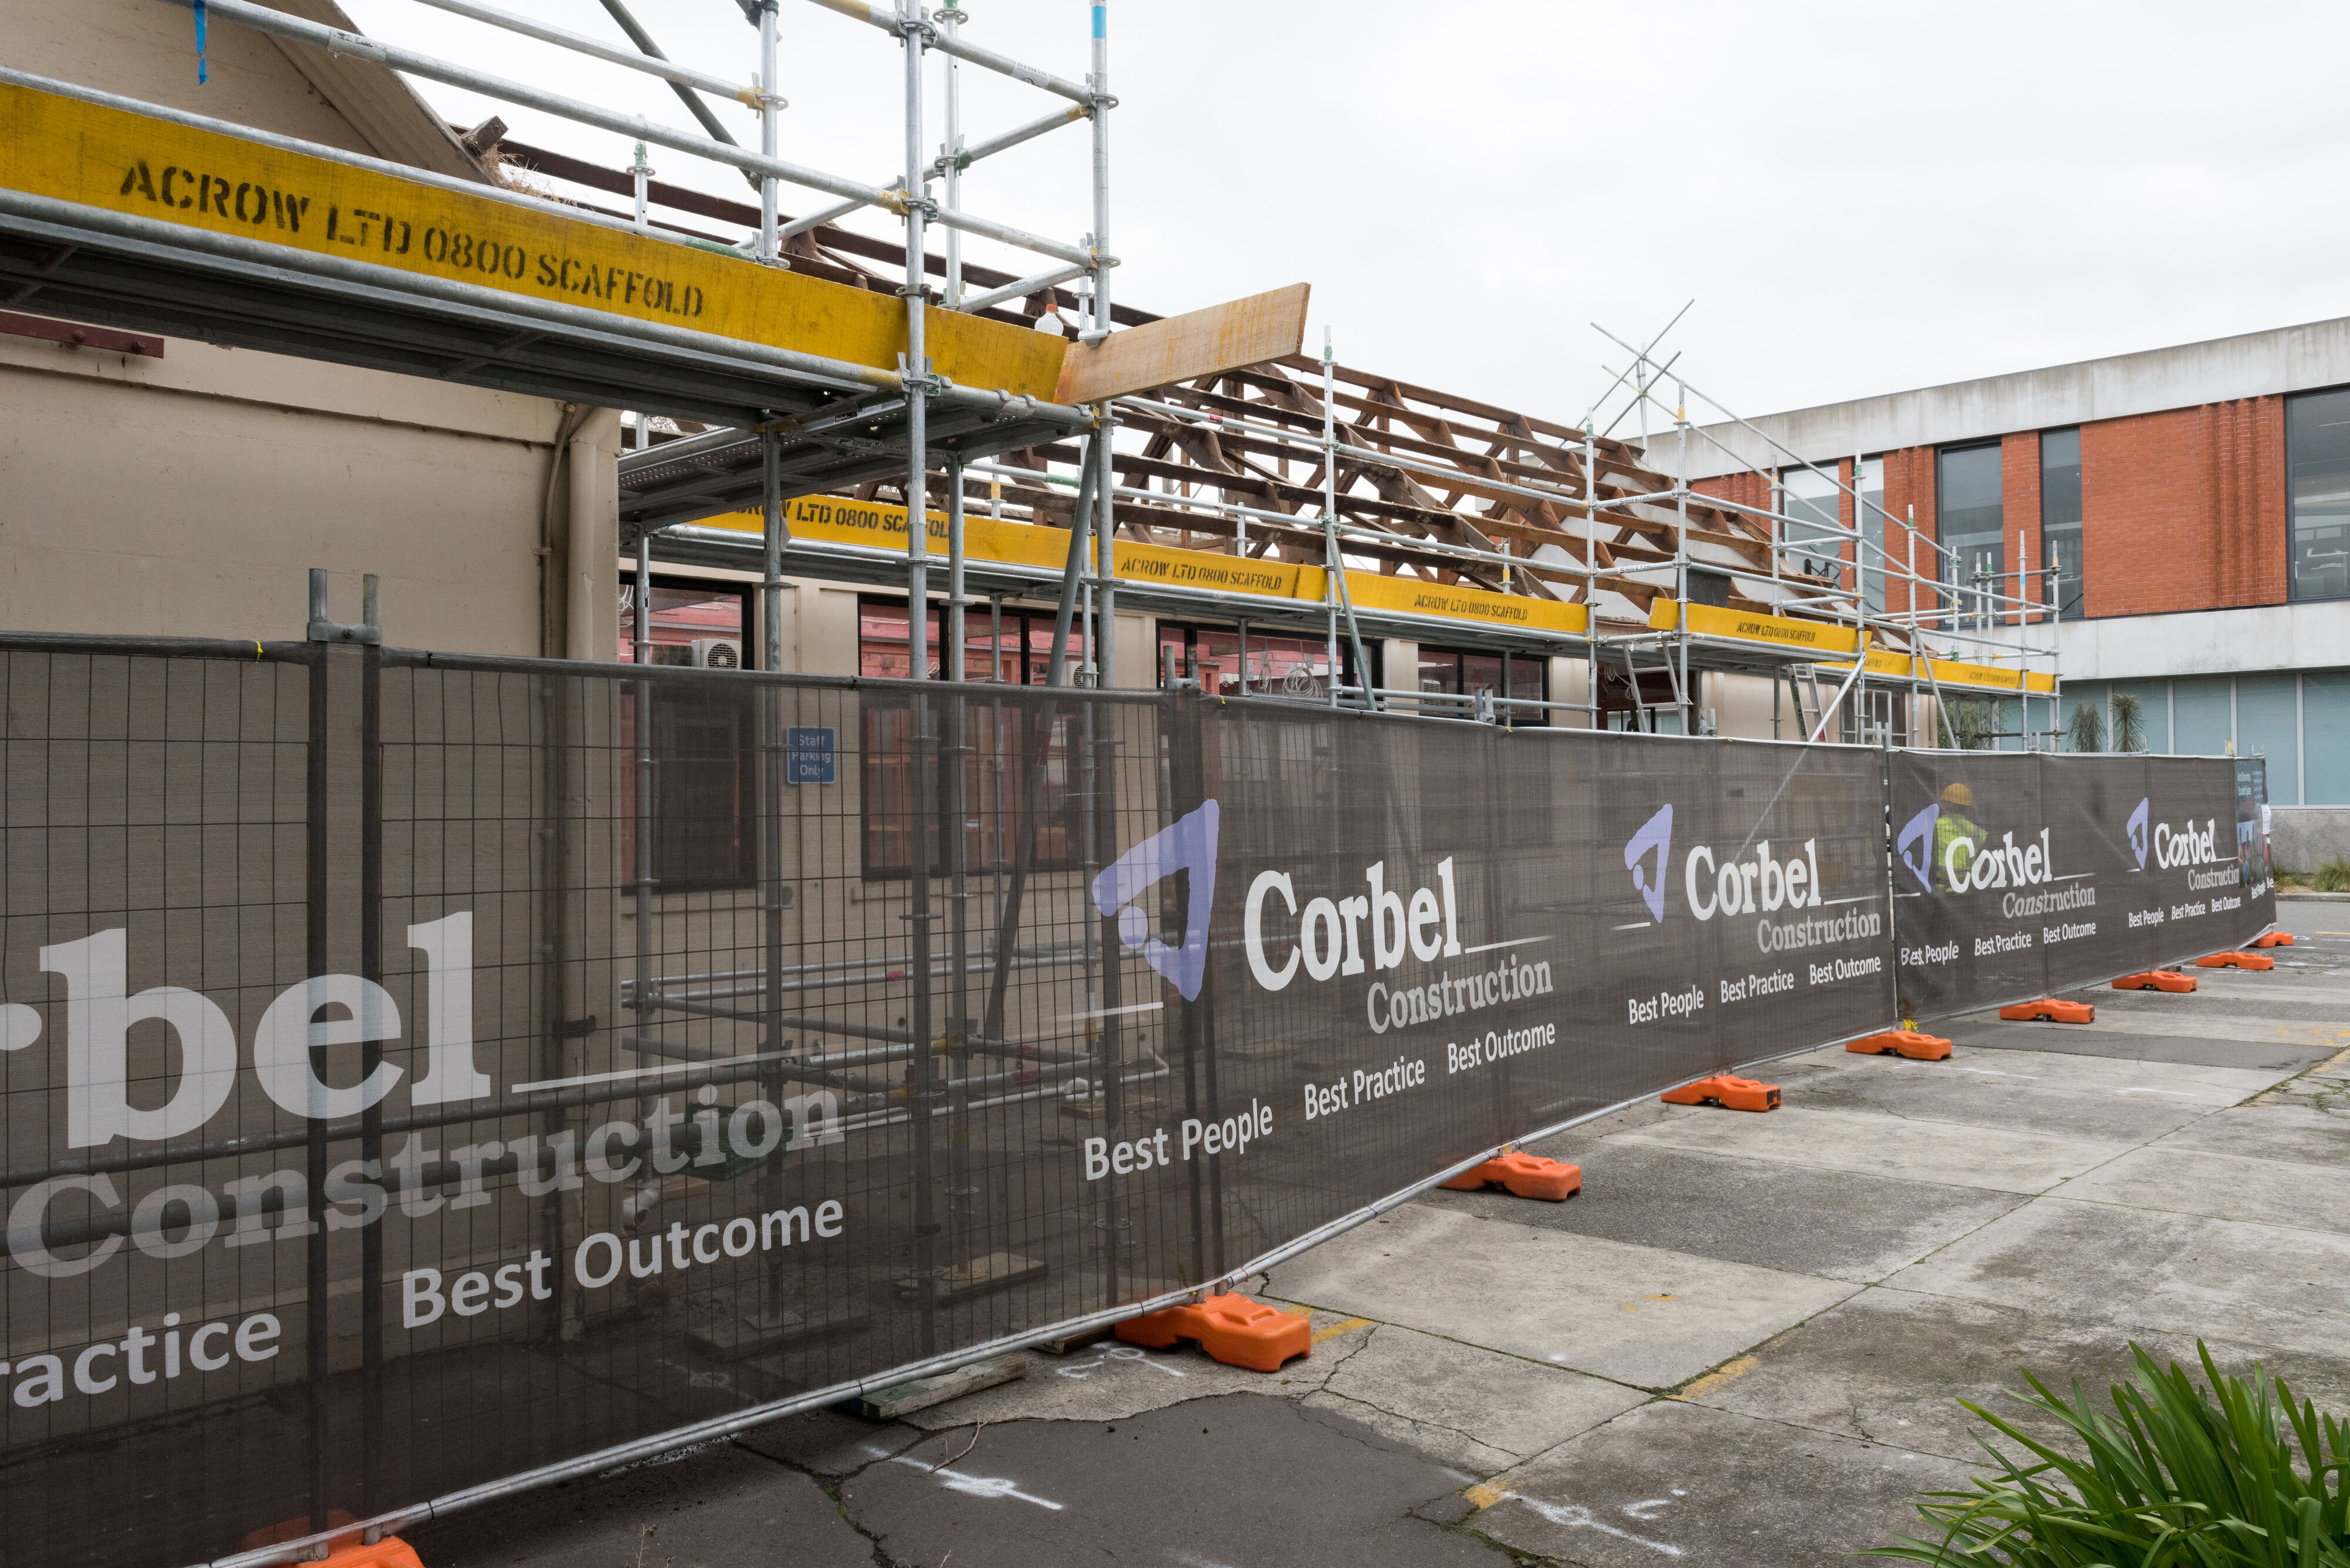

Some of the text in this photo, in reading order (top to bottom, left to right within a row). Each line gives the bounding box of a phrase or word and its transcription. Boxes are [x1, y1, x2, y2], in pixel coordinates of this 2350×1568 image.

[120, 159, 703, 317] ACROW LTD 0800 SCAFFOLD
[797, 502, 832, 523] LTD
[836, 508, 879, 529] 0800
[1121, 558, 1282, 590] ACROW LTD 0800 SCAFFOLD
[1414, 594, 1528, 621] ACROW LTD 0800 SCAFFOLD
[1736, 622, 1816, 642] ACROW LTD 0800 SCAFFOLD
[792, 749, 831, 763] Parking
[799, 734, 826, 746] Staff
[800, 764, 824, 778] Only
[1945, 827, 2053, 893] Corbel
[2154, 818, 2217, 869] Corbel
[1685, 838, 1822, 921] Corbel
[2003, 882, 2096, 919] Construction
[1243, 856, 1461, 992] Corbel
[1758, 906, 1881, 953] Construction
[2129, 911, 2143, 928] Best
[2143, 907, 2164, 926] People
[2172, 906, 2184, 921] Best
[2184, 901, 2205, 918] Practice
[2211, 898, 2222, 912] Best
[1925, 941, 1959, 965] People
[1974, 937, 1996, 956] Best
[1996, 931, 2031, 953] Practice
[2043, 925, 2061, 944] Best
[2062, 922, 2096, 940] Outcome
[1367, 953, 1554, 1035] Construction
[1628, 955, 1882, 1025] Best People Best Practice Best Outcome
[0, 911, 491, 1149] bel
[1084, 1023, 1556, 1182] Best People Best Practice Best Outcome
[6, 1084, 847, 1278] Construction
[0, 1200, 844, 1408] actice Best Outcome
